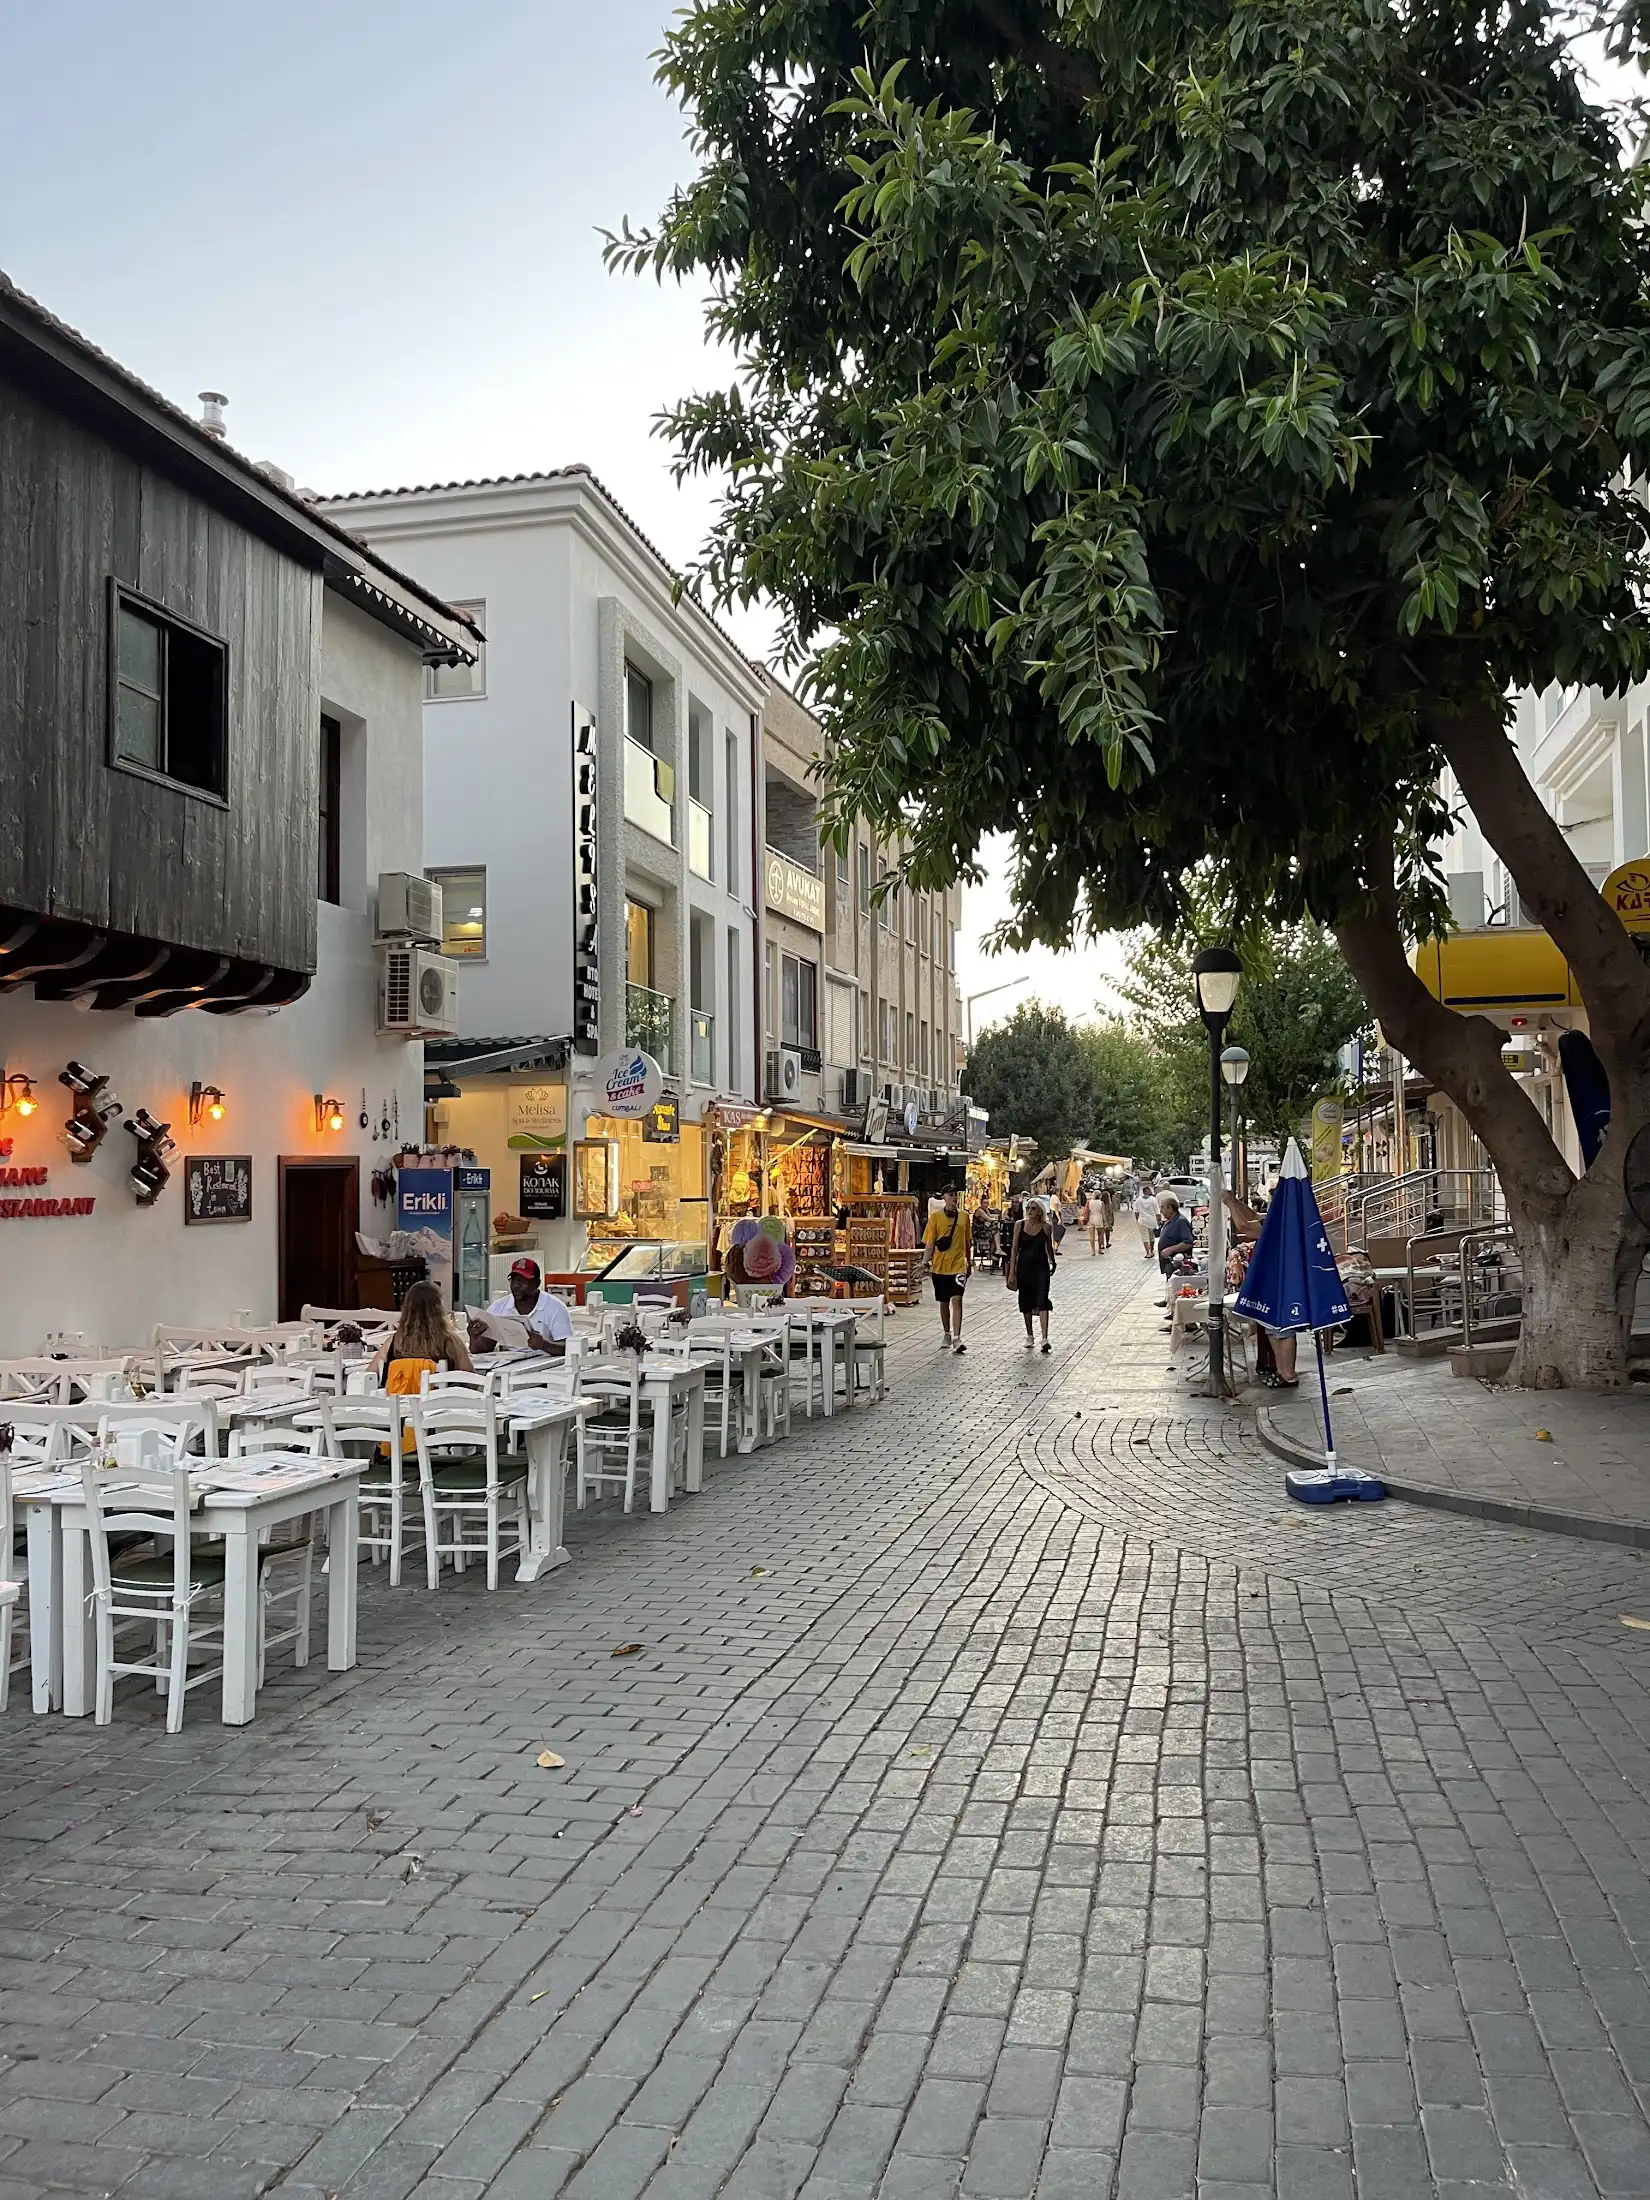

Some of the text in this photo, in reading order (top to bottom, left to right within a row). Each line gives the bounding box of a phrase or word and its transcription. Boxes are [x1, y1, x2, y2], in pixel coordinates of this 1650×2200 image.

[612, 1067, 629, 1080] Ice
[606, 1075, 641, 1091] Cream
[617, 1085, 641, 1099] cake
[518, 1103, 556, 1116] Melisa
[203, 1161, 221, 1176] Best
[522, 1177, 560, 1188] KONAK
[402, 1192, 446, 1211] Erikli
